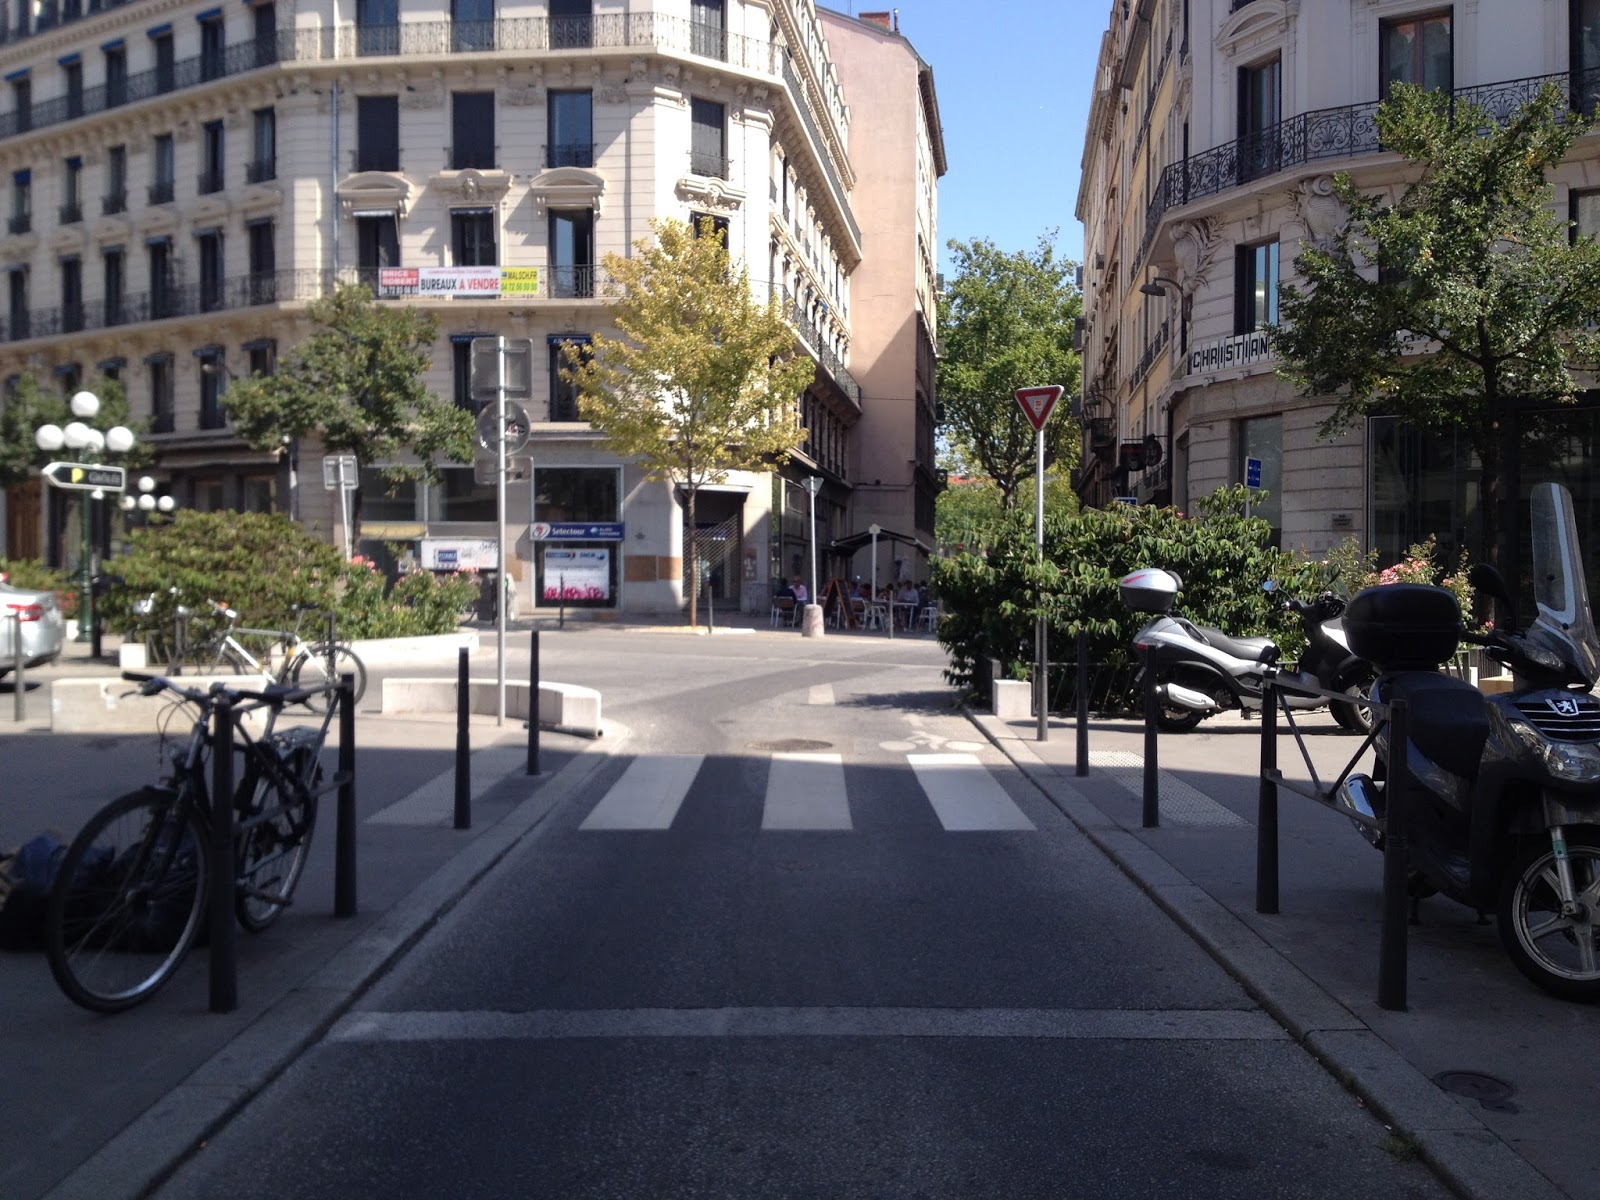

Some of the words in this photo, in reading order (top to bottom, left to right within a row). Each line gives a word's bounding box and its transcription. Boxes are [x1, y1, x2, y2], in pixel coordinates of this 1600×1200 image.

[382, 269, 408, 277] BRICE
[382, 277, 418, 286] ROBERT
[421, 279, 457, 290] BUREAUX
[459, 278, 466, 290] A
[469, 278, 499, 290] VENDRE
[1193, 337, 1268, 369] CHRISTIAN
[552, 527, 585, 535] Selectour
